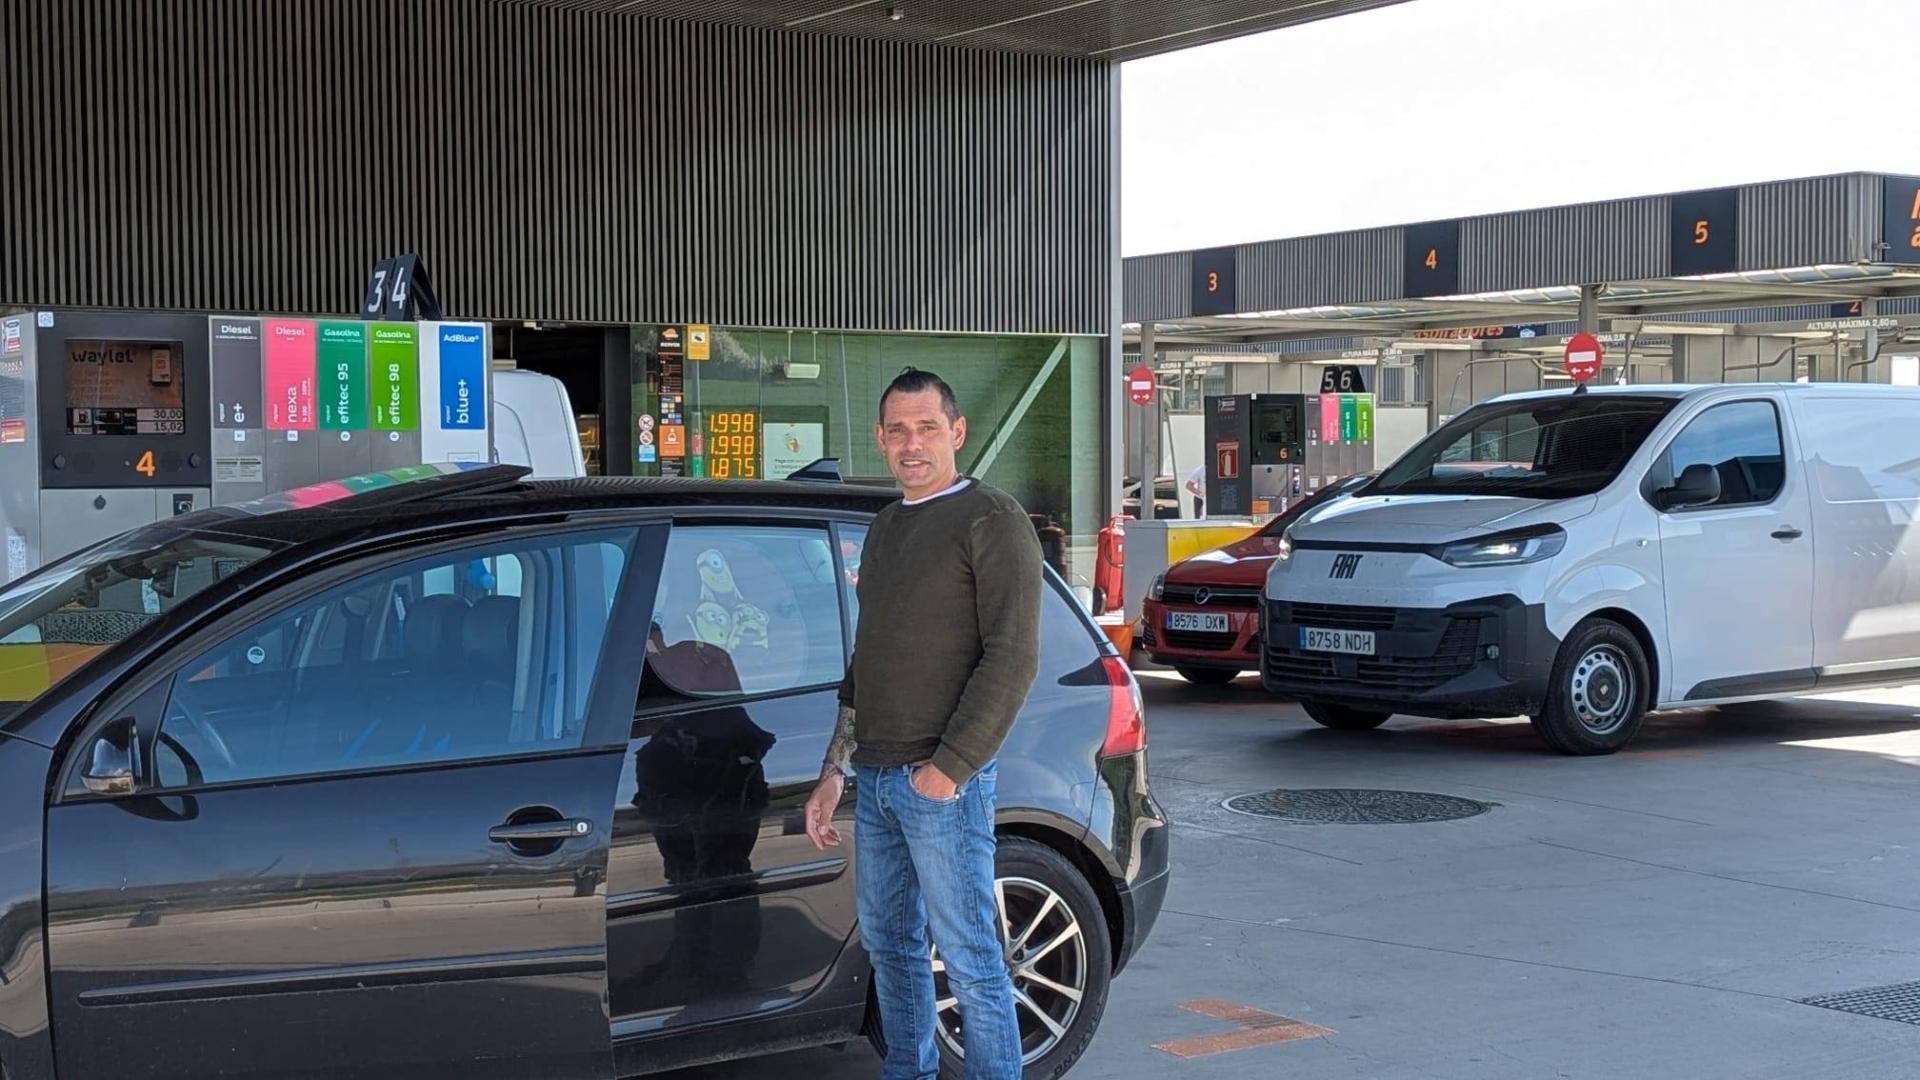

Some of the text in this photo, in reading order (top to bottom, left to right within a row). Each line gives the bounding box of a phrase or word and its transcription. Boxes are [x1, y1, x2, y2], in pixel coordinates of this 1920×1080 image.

[1695, 221, 1709, 244] 5
[1425, 249, 1437, 269] 4
[368, 267, 406, 312] 3 4
[1208, 272, 1218, 291] 3
[1849, 301, 1859, 313] 2
[221, 325, 252, 334] Diesel
[275, 326, 305, 336] Diesel
[324, 328, 360, 337] Gasolina
[375, 330, 411, 338] Gasolina
[1807, 321, 1837, 330] ALTURA
[71, 349, 134, 366] waylet
[337, 363, 349, 381] 95
[388, 363, 400, 381] 98
[1324, 370, 1351, 391] 5 6
[287, 386, 297, 423] nexa
[337, 384, 349, 424] efitec
[388, 384, 400, 424] efitec
[456, 378, 469, 424] blue+
[153, 410, 182, 420] 30,00
[233, 402, 245, 423] e+
[153, 422, 183, 433] 15,02
[710, 413, 754, 433] 1.998
[711, 435, 755, 455] 1.998
[1279, 447, 1288, 459] 6
[136, 450, 156, 477] 4
[711, 457, 755, 479] 1.875
[1328, 553, 1364, 580] FIAT
[1174, 613, 1199, 629] 8576
[1308, 630, 1371, 652] 8758 NDH
